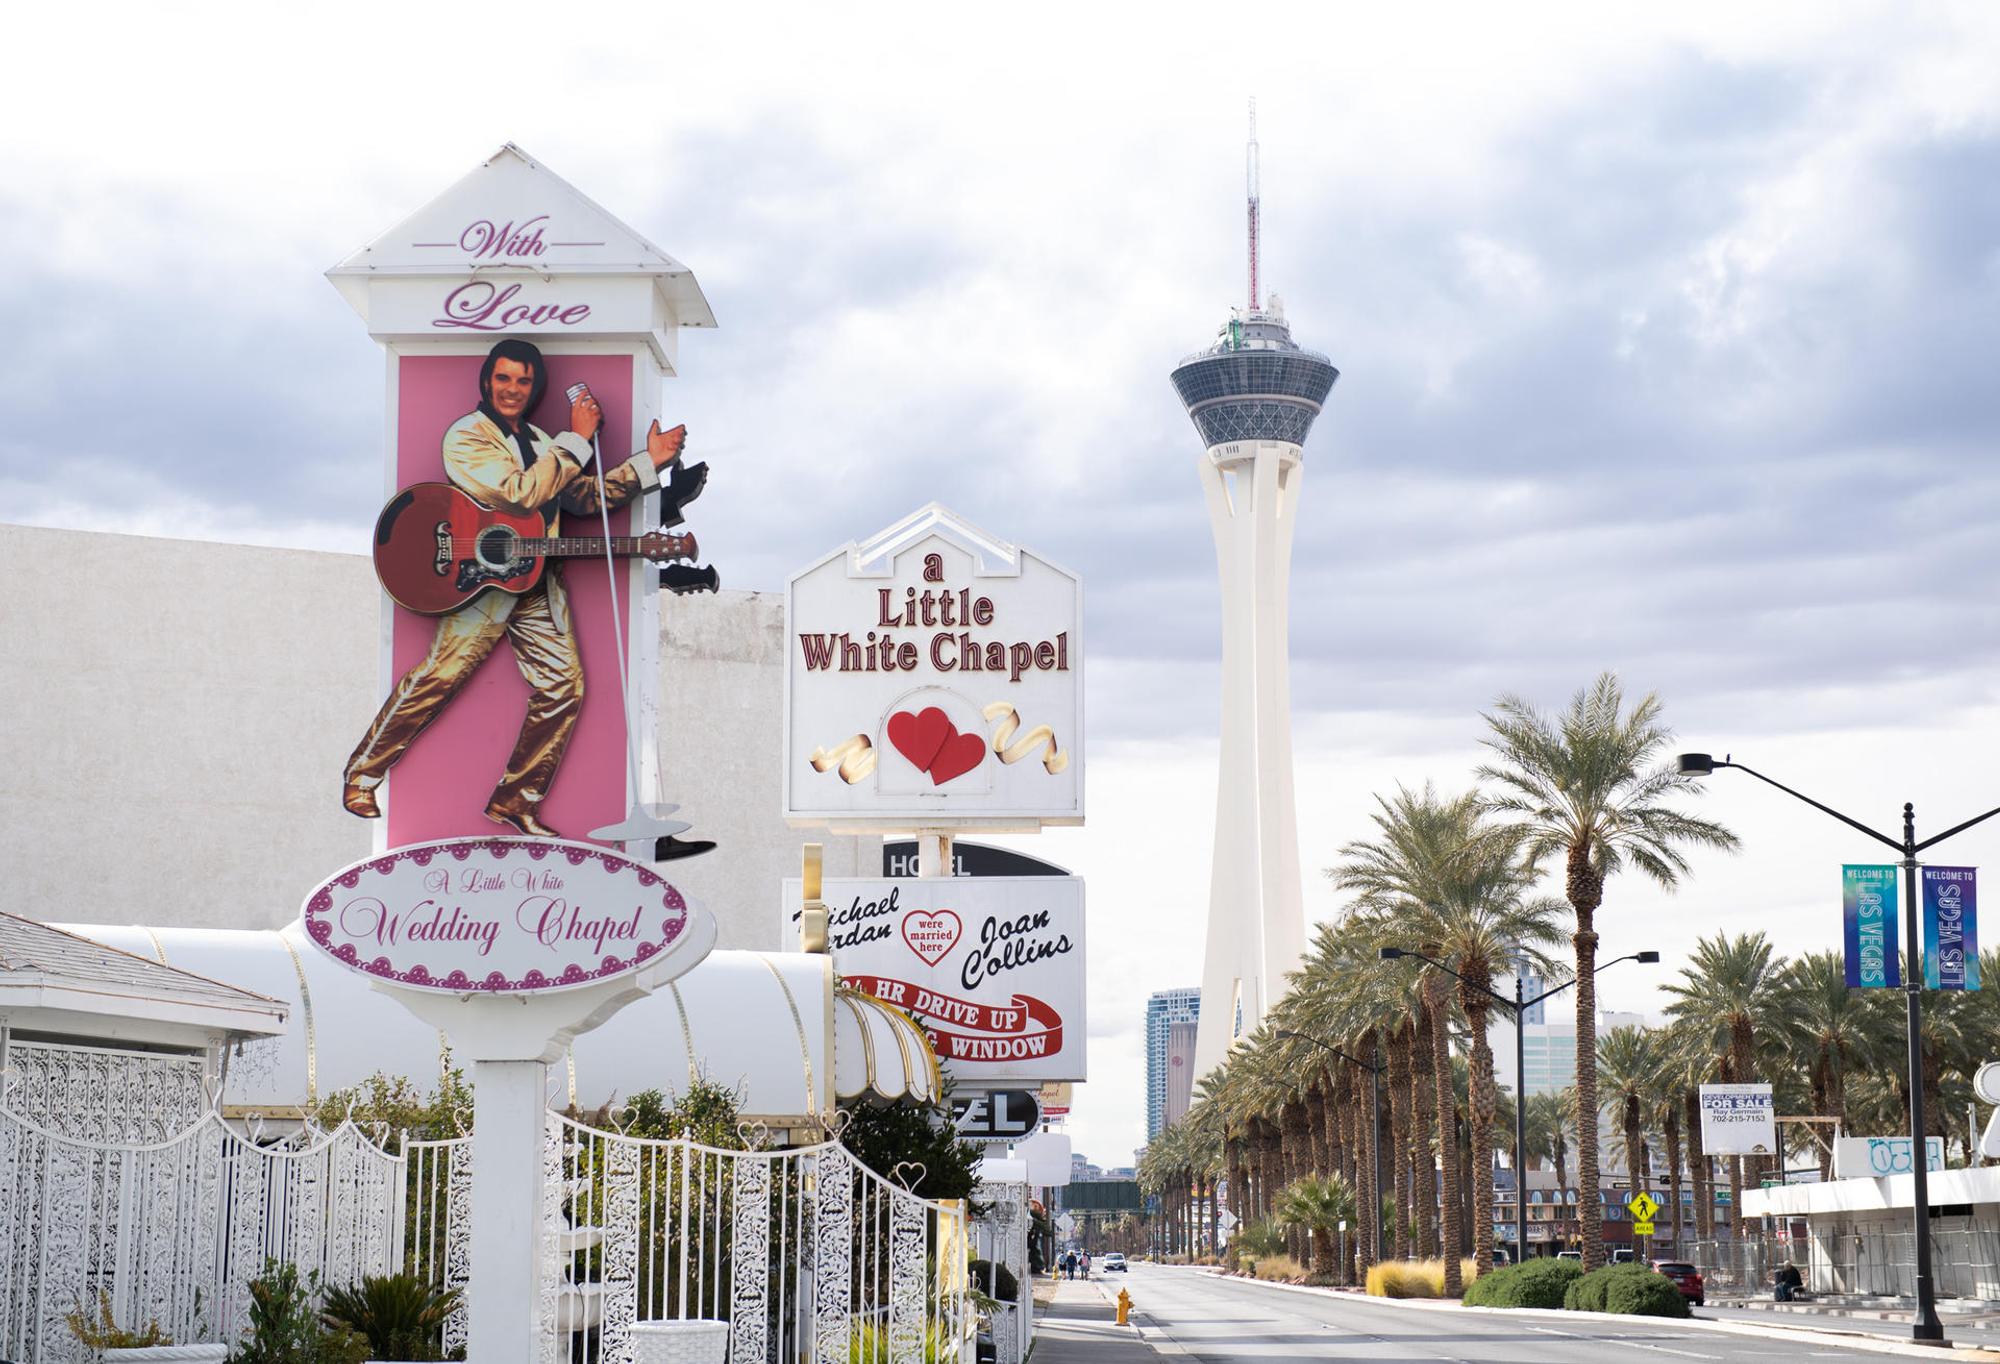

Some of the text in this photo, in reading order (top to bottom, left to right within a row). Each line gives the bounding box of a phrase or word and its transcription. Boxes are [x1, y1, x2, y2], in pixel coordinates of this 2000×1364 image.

[459, 216, 550, 259] With
[432, 281, 592, 331] Love
[923, 553, 945, 582] a
[877, 587, 994, 628] Little
[799, 631, 1069, 682] White Chapel
[424, 867, 564, 894] A Little White
[1846, 869, 1894, 879] WELCOME TO
[1925, 870, 1973, 881] WELCOME TO
[340, 895, 643, 956] Wedding Chapel
[792, 886, 899, 926] ichael
[919, 920, 943, 928] were
[910, 930, 952, 940] married
[920, 942, 943, 951] here
[981, 910, 1050, 959] Joan
[1856, 881, 1885, 982] LAS VEGAS
[1938, 884, 1964, 985] LAS VEGAS
[961, 934, 1073, 990] Collins
[874, 980, 906, 1003] HR
[914, 990, 980, 1026] DRIVE
[990, 1010, 1018, 1030] UP
[950, 1034, 1048, 1059] WINDOW
[1704, 1099, 1773, 1108] FOR SALE
